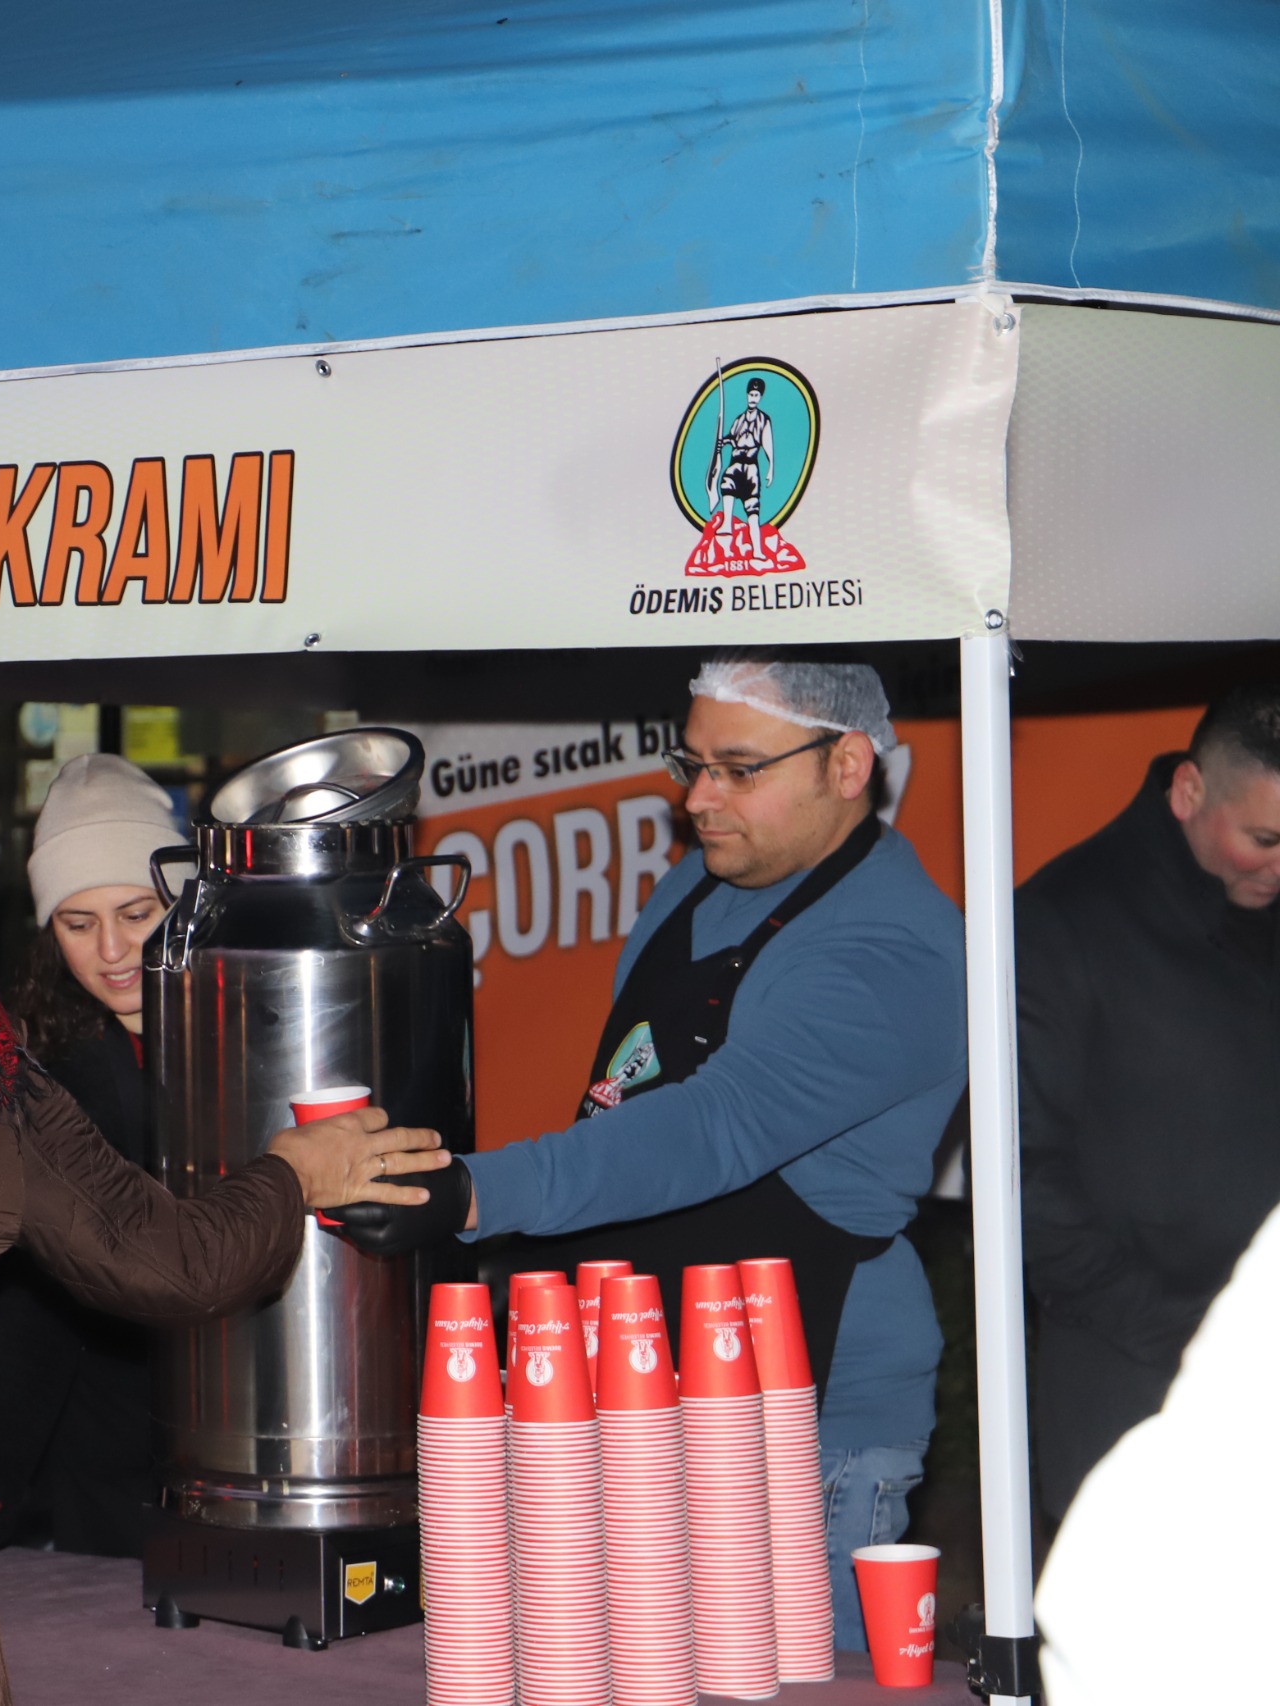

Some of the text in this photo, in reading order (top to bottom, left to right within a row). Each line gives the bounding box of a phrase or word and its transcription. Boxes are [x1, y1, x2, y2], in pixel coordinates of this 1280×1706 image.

[723, 559, 749, 572] 1881
[431, 752, 521, 798] Güne
[533, 716, 626, 779] sıcak
[431, 794, 672, 989] ÇORB
